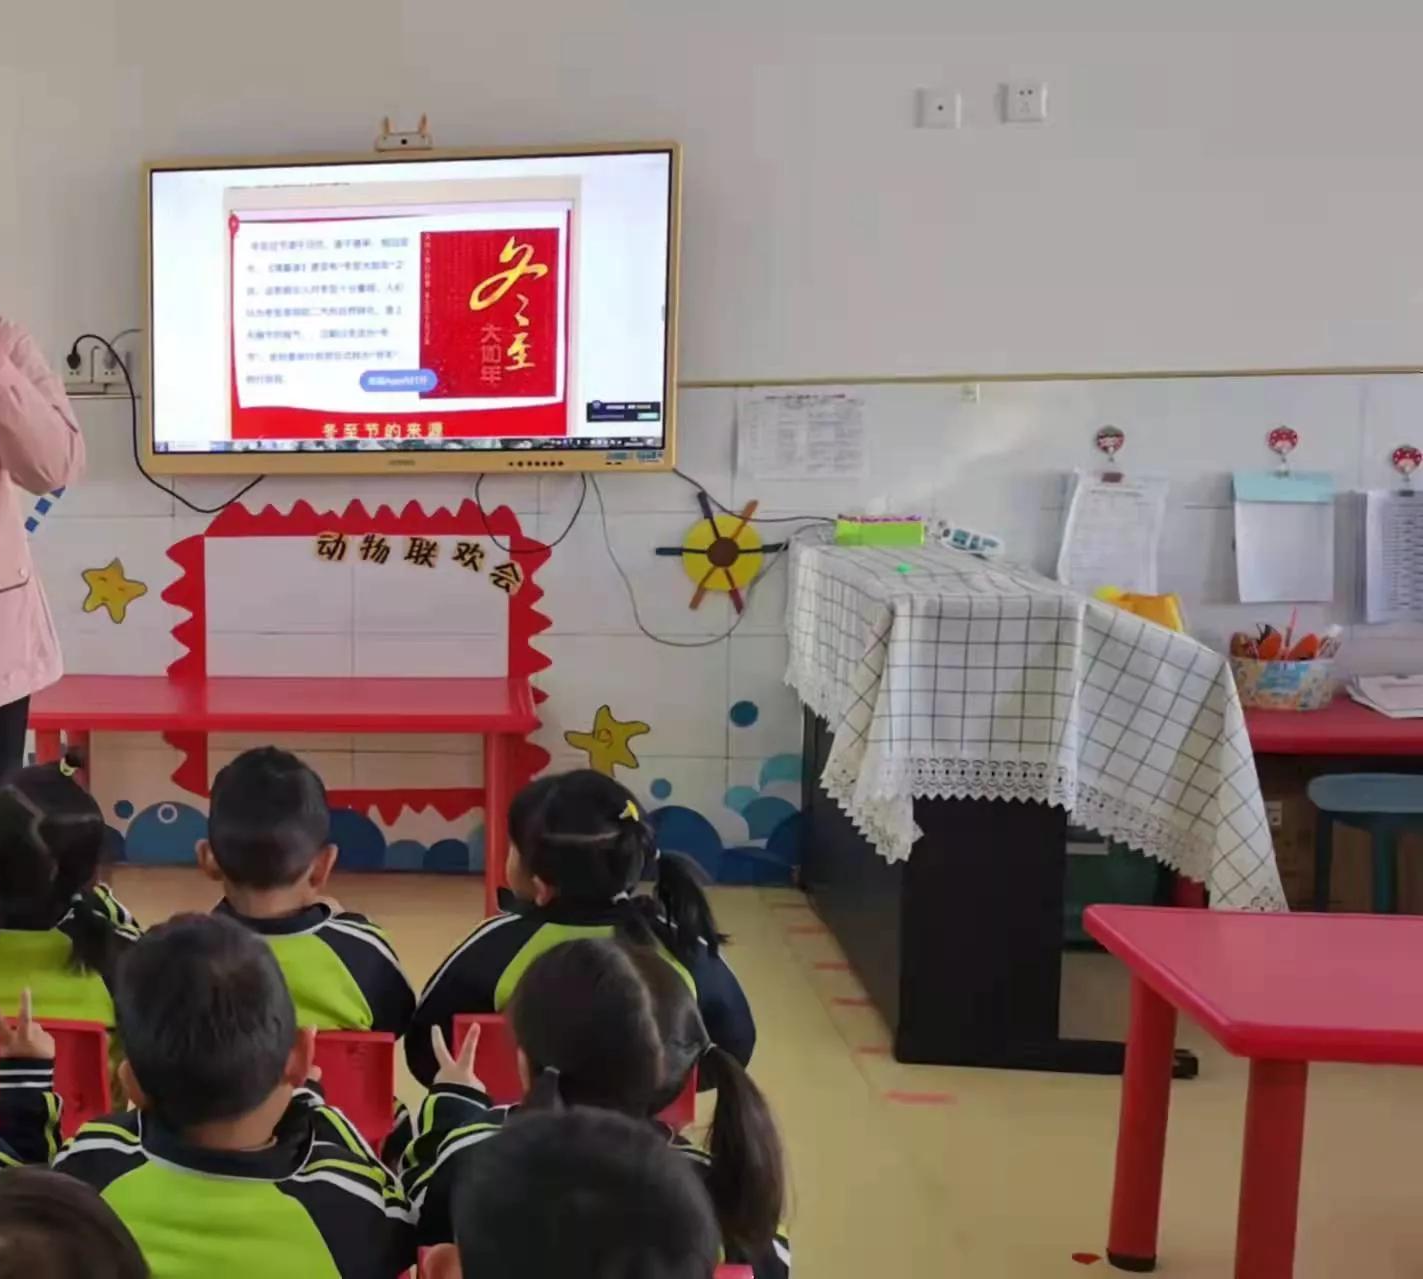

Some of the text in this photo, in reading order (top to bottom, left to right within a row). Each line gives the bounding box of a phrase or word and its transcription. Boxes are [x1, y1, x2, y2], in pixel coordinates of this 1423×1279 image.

[316, 532, 522, 593] 动物联欢会
